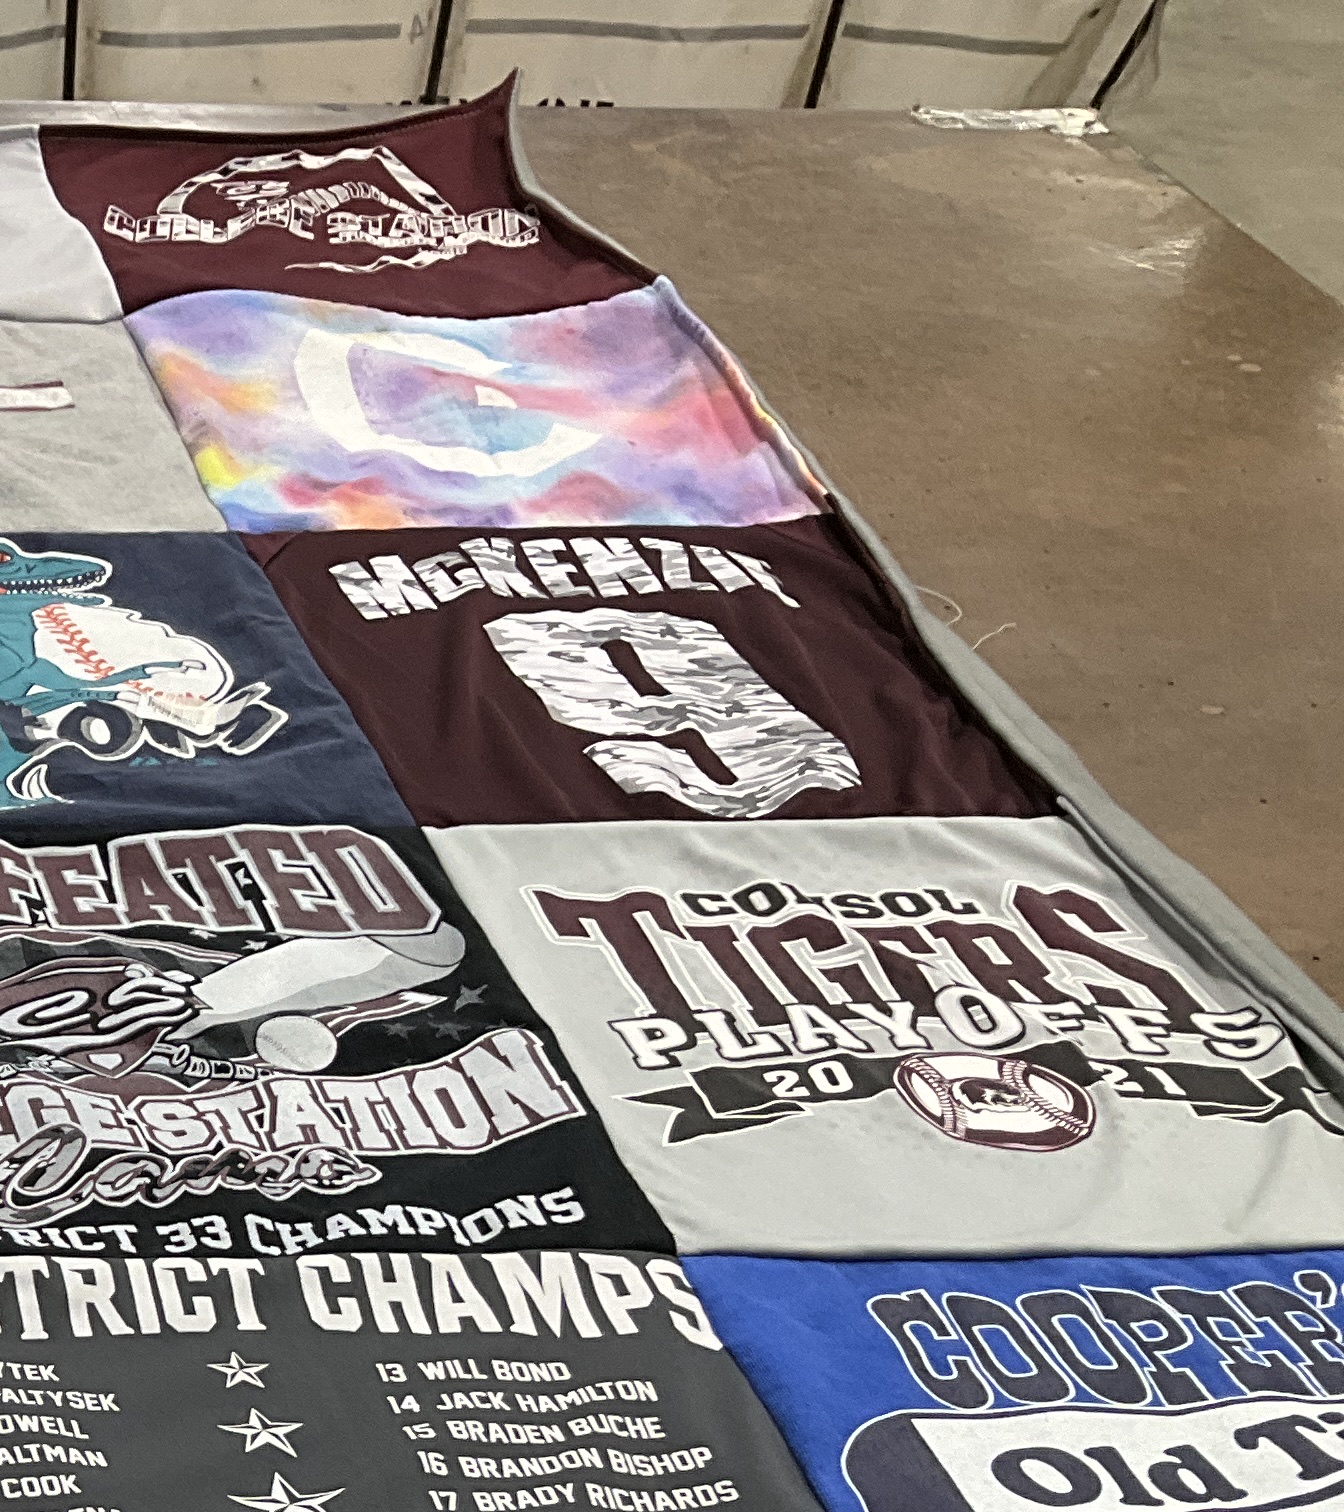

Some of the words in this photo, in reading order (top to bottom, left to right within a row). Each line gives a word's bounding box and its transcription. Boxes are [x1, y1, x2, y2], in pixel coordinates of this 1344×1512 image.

[482, 606, 862, 819] 9
[525, 880, 1228, 1038] TIGERS
[608, 983, 1289, 1070] PLAYOFFS
[138, 1027, 587, 1160] STATION
[763, 1059, 855, 1097] 20
[156, 1215, 232, 1253] 33
[245, 1189, 587, 1258] CHAMPIONS
[295, 1253, 723, 1351] CHAMPS
[867, 1269, 1344, 1411] COOPER'
[376, 1364, 407, 1383] 13
[417, 1360, 488, 1381] WILL
[492, 1360, 571, 1381] BOND
[989, 1444, 1249, 1508] Old
